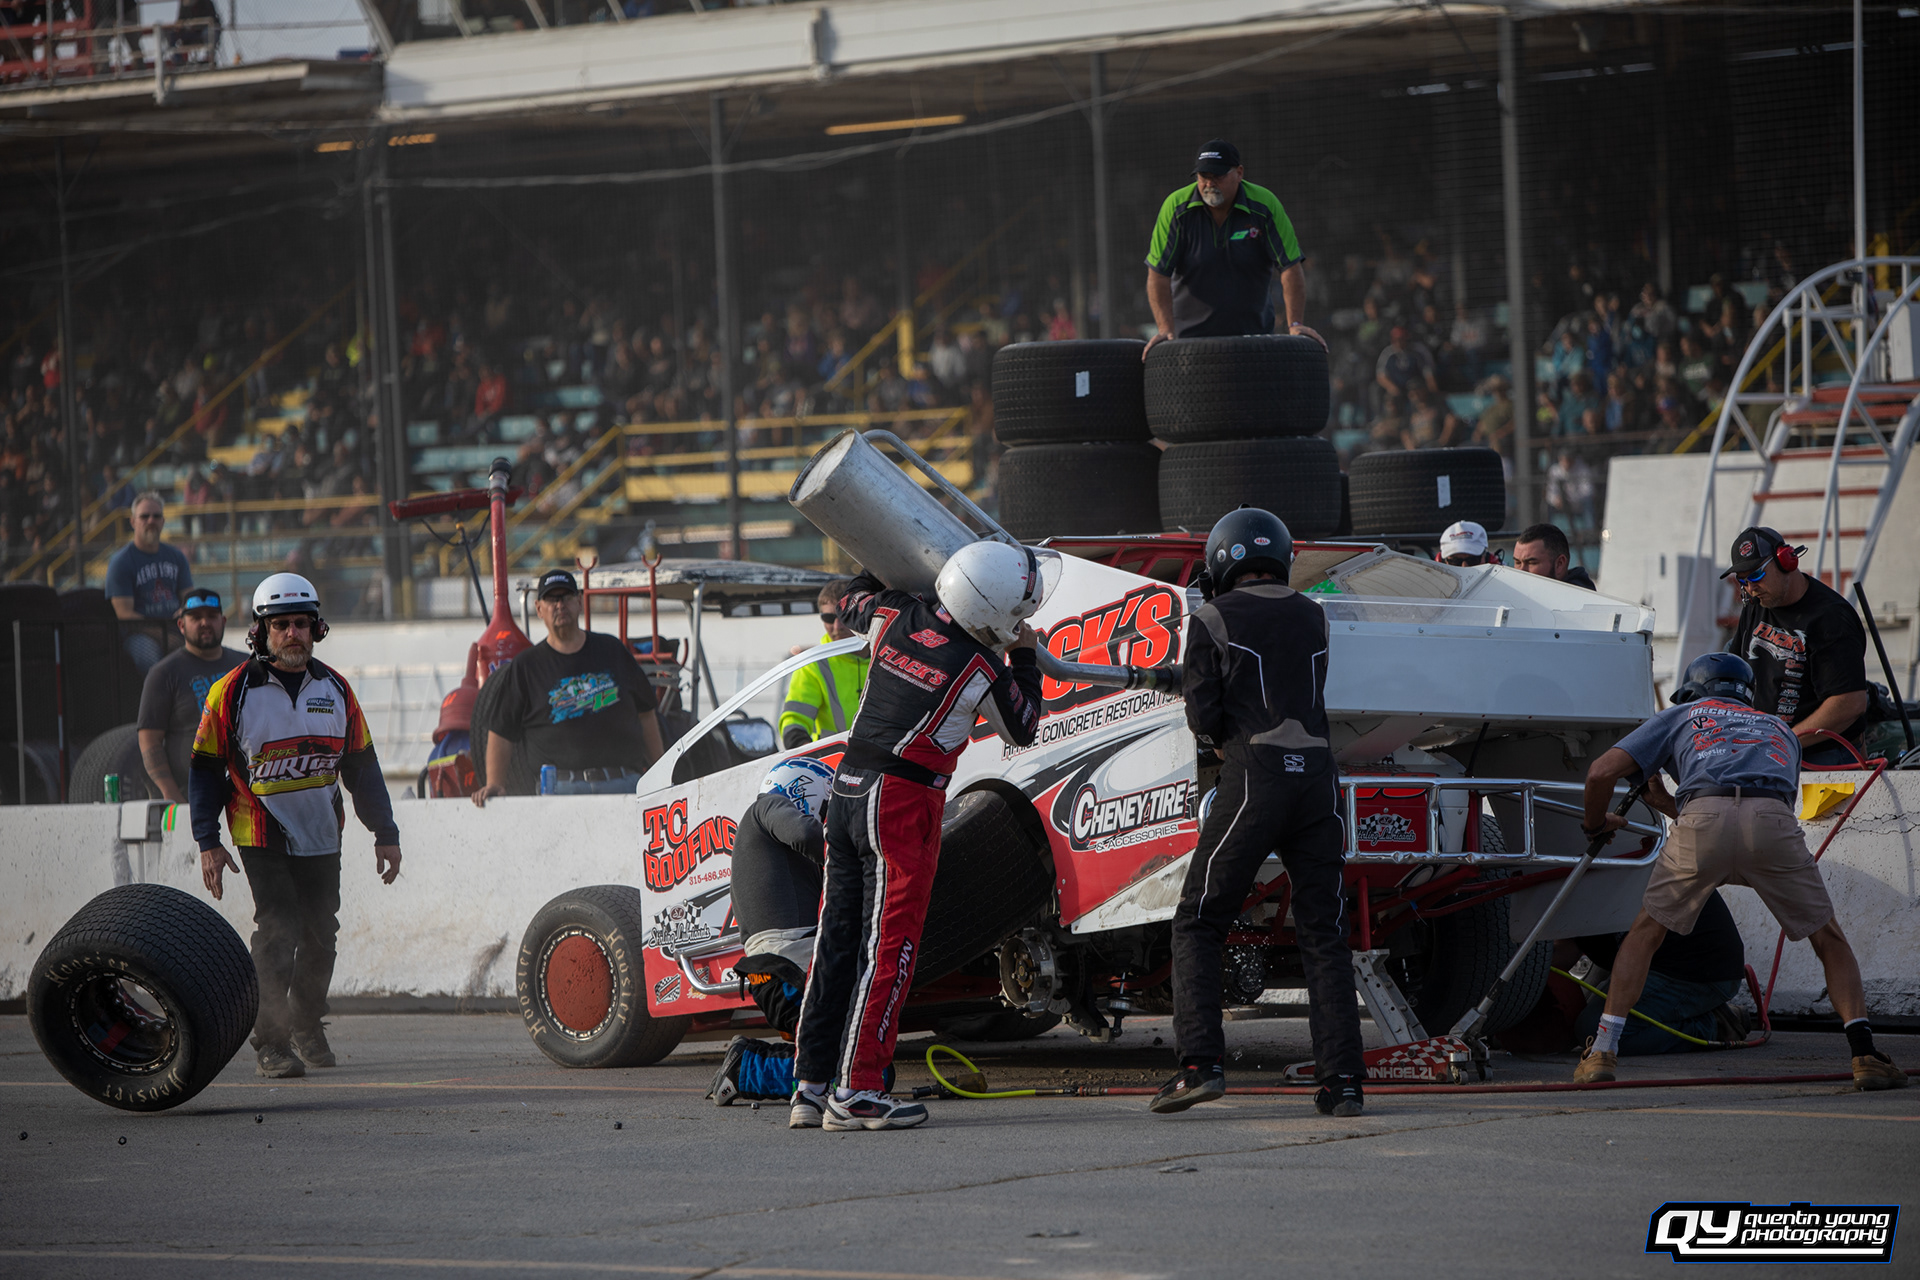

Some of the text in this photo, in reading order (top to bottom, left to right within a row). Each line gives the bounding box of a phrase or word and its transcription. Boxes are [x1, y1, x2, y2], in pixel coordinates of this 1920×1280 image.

[877, 645, 950, 688] FLACK'S
[1041, 708, 1104, 745] CONCRETE
[247, 748, 298, 770] SUPER
[644, 798, 687, 854] TC
[1074, 782, 1188, 839] CHENEY TIRE
[644, 816, 738, 893] ROOFING
[1108, 823, 1178, 848] ACCESSORIES
[44, 951, 129, 988] Hoosier
[603, 927, 632, 1025] Hoosier
[877, 940, 914, 1042] McCreadie
[517, 944, 548, 1040] Hoosier
[102, 1066, 184, 1103] Hoosier
[1366, 1066, 1437, 1080] NNHOELZL
